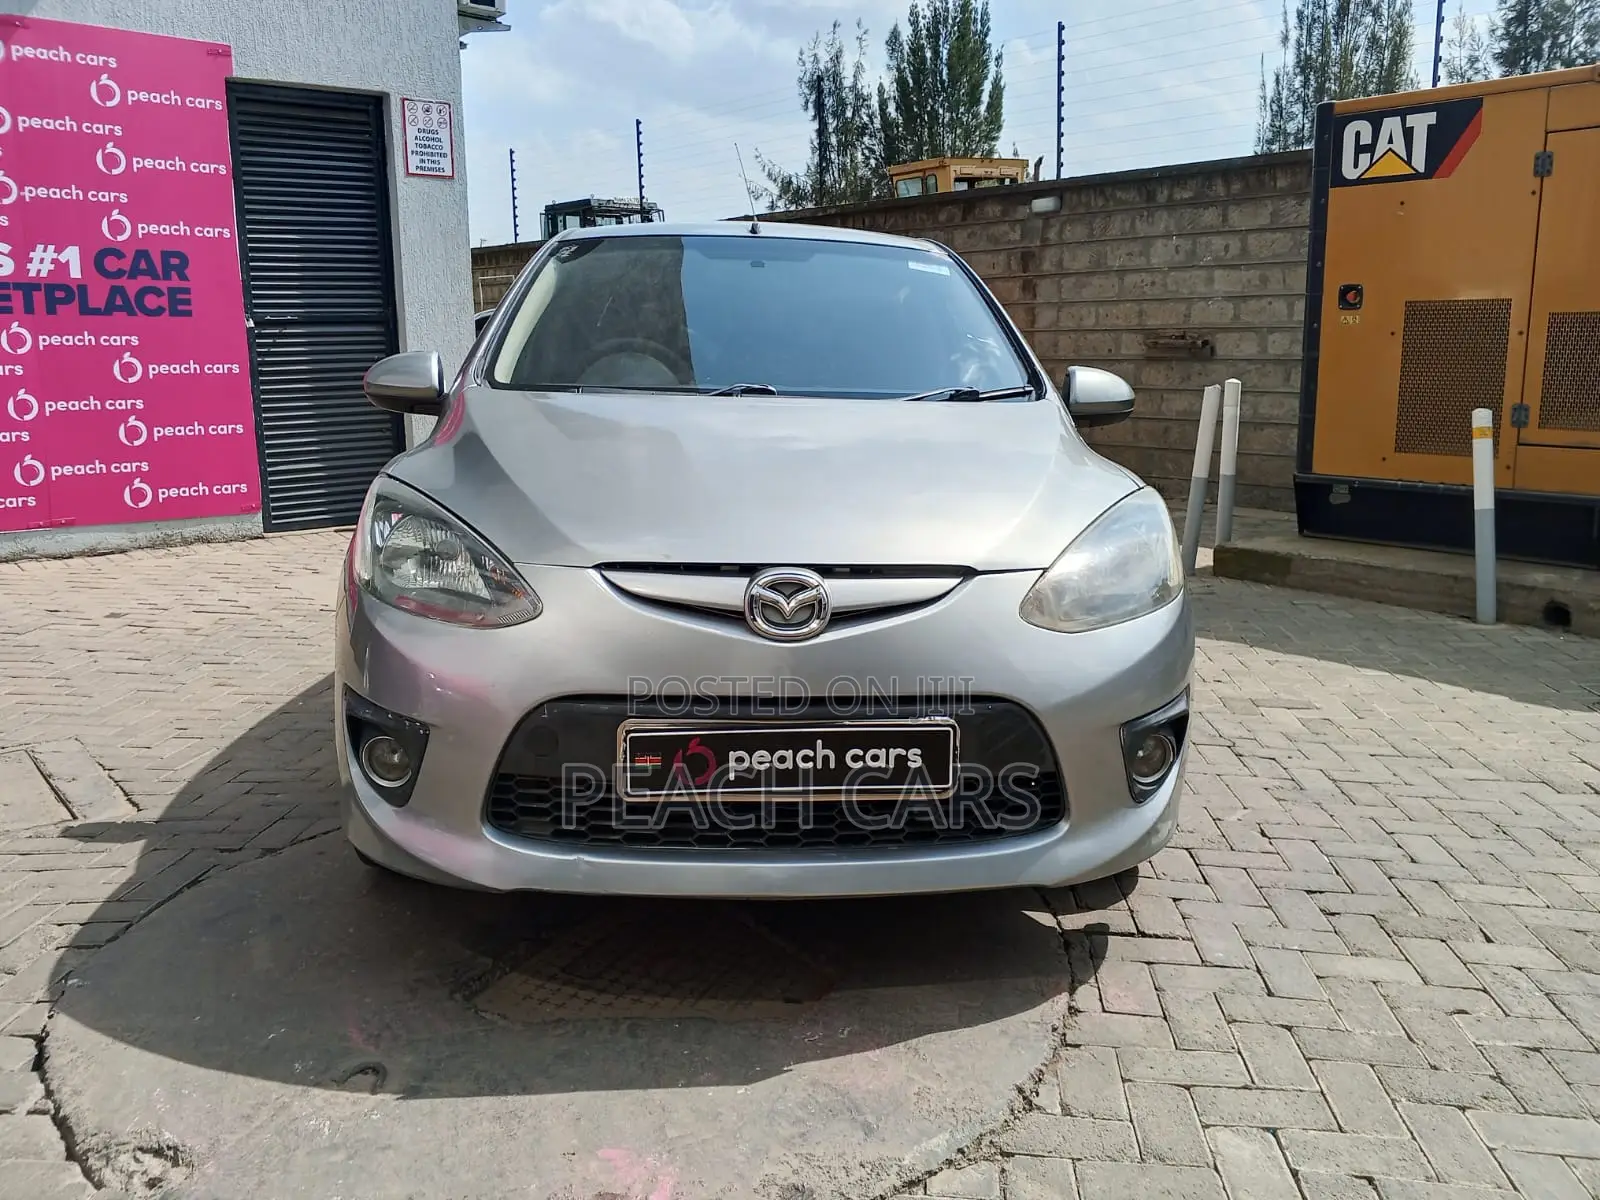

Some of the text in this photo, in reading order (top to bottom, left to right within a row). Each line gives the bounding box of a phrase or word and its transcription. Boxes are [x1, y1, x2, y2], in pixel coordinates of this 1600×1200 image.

[11, 44, 118, 69] peach cars
[127, 89, 224, 111] peach cars
[17, 115, 123, 137] peach cars
[417, 128, 439, 136] DRUGS
[414, 136, 443, 144] ALCOHOL
[415, 143, 444, 151] TOBACCO
[1341, 111, 1437, 180] CAT
[411, 150, 448, 159] PROHIBITED
[132, 156, 227, 175] peach cars
[24, 184, 129, 204] peach cars
[137, 220, 232, 239] peach cars
[26, 243, 82, 279] #1
[93, 247, 191, 282] CAR
[0, 281, 193, 317] ETPLACE
[38, 330, 140, 351] peach cars
[148, 359, 240, 380] peach cars
[44, 395, 145, 417] peach cars
[153, 421, 244, 442] peach cars
[50, 459, 150, 481] peach cars
[157, 481, 248, 503] peach cars
[728, 738, 923, 781] peach cars
